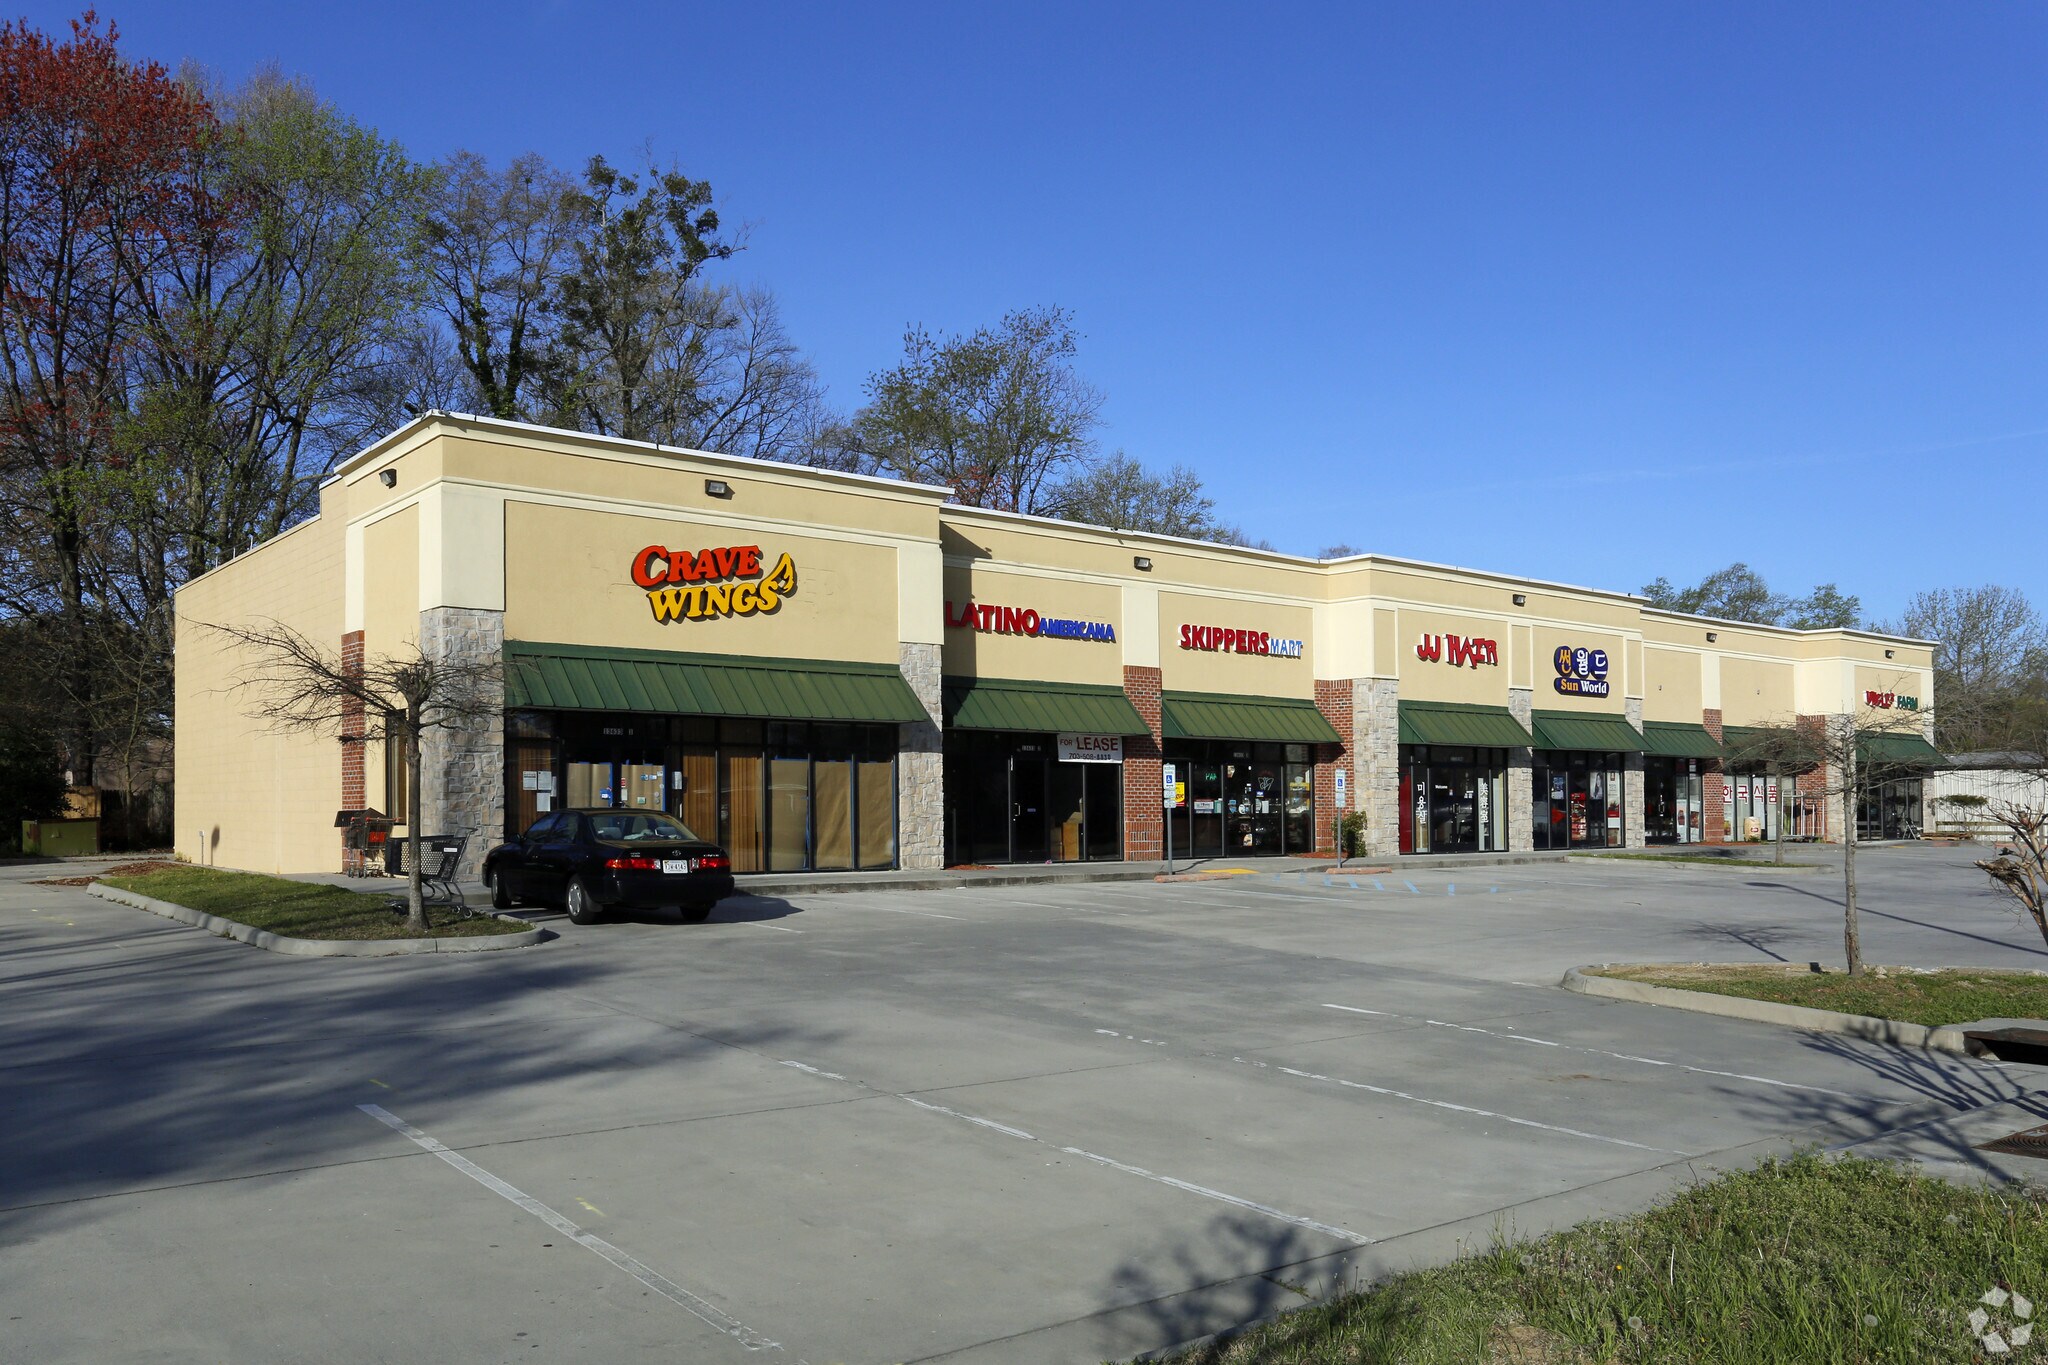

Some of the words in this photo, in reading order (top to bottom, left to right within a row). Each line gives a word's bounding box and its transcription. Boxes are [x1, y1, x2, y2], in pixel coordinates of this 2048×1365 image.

[632, 545, 763, 589] CRAVE
[646, 572, 789, 625] WINGS
[945, 600, 1040, 635] LATINO
[1038, 617, 1116, 643] AMERICANA
[1415, 633, 1441, 662] JJ
[1443, 633, 1498, 669] HAIR
[1560, 679, 1579, 692] Sun
[1580, 680, 1607, 694] World
[1060, 738, 1073, 746] FOR
[1076, 736, 1119, 751] LEASE
